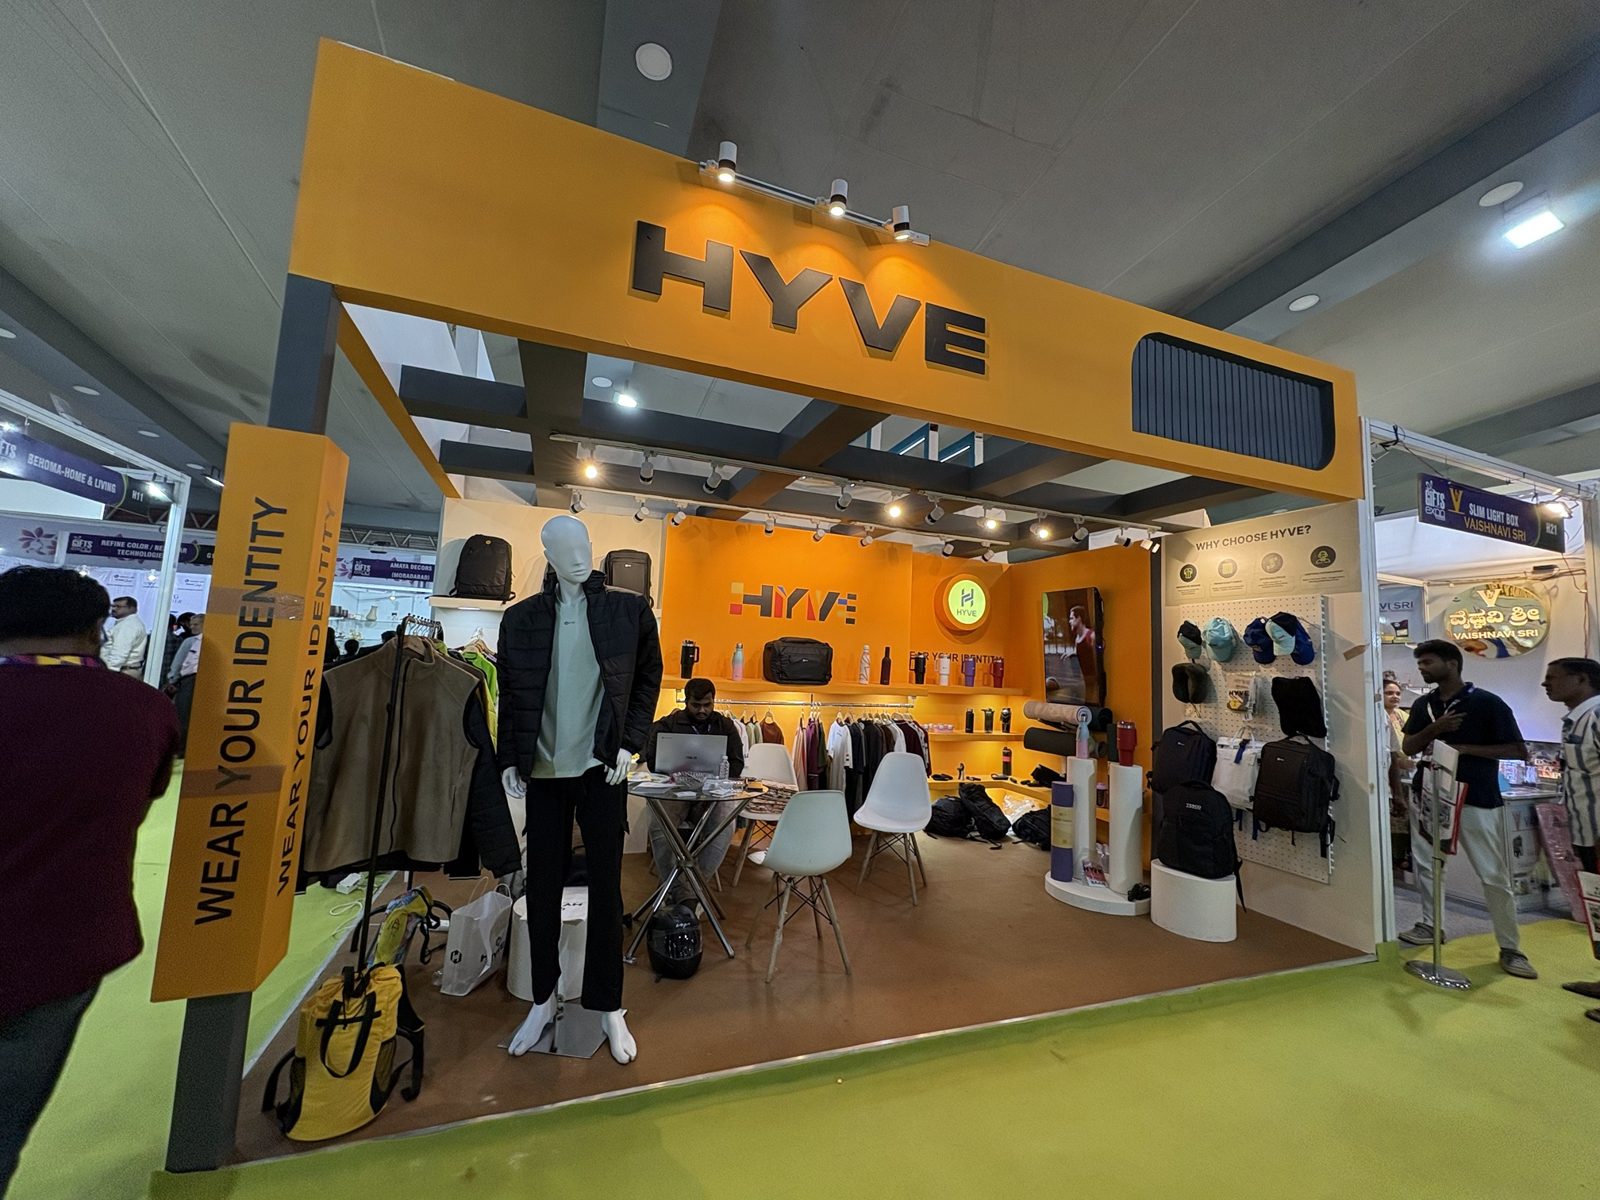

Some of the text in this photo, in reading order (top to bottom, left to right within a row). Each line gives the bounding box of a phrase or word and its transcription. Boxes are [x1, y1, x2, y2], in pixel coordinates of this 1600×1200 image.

[632, 220, 986, 376] HYVE
[0, 440, 17, 459] FTS
[27, 453, 87, 484] BEHOMA-HOME
[87, 475, 94, 486] &
[94, 478, 117, 494] LIVING
[132, 489, 144, 502] H11
[1425, 489, 1445, 510] GIFTS
[1469, 502, 1519, 527] SLIM LIGHT BOX
[1196, 524, 1311, 551] WHY CHOOSE HYVE?
[1464, 516, 1526, 543] VAISHNAVI SRI
[1546, 523, 1558, 536] H21
[71, 540, 93, 549] GIFTS
[101, 540, 126, 548] REFINE
[117, 550, 164, 559] TECHNOLOGIE
[354, 564, 371, 572] GIFTS
[729, 582, 858, 625] HYVE
[956, 608, 977, 618] HYVE
[1393, 601, 1414, 610] SRI
[1453, 629, 1539, 640] VAISHNAVI SRI
[276, 502, 336, 896] WEAR YOUR IDENTITY
[195, 497, 288, 926] WEAR YOUR IDENTITY
